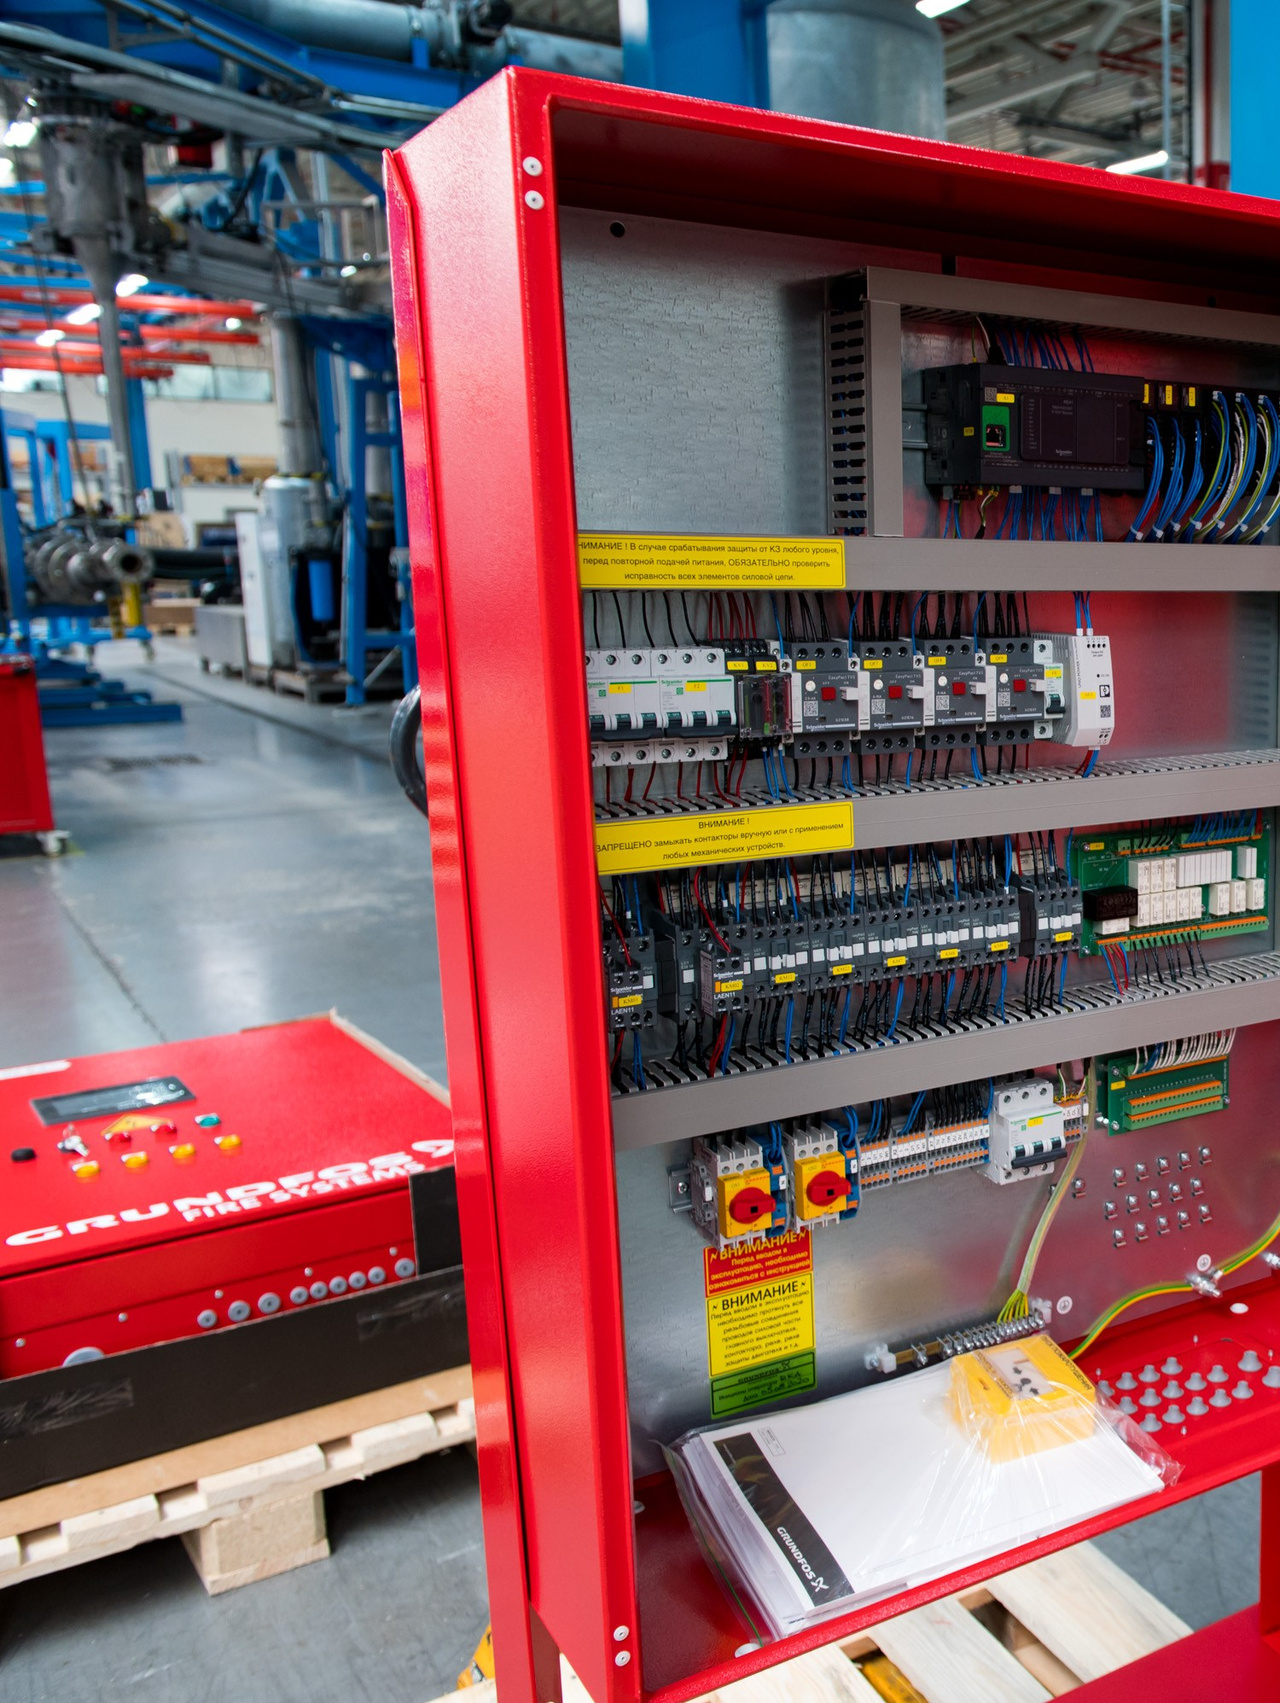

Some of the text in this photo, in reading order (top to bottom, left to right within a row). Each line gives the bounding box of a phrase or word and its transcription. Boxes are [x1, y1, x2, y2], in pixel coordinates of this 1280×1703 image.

[578, 542, 623, 551] НИМАНИЕ
[630, 542, 636, 550] В
[638, 544, 667, 553] случае
[668, 543, 725, 553] срабатывания
[812, 547, 839, 555] уровня,
[583, 558, 609, 566] перед
[611, 557, 654, 566] повторной
[656, 558, 690, 566] подачей
[692, 559, 726, 567] питания,
[728, 558, 790, 567] ОБЯЗАТЕЛЬНО
[624, 573, 676, 581] исправность
[698, 818, 745, 829] ВНИМАНИЕ
[596, 840, 652, 853] ЗАПРЕЩЕНО
[654, 838, 693, 847] замыкать
[694, 833, 739, 843] контакторы
[740, 829, 772, 840] вручную
[795, 823, 844, 834] применением
[662, 841, 785, 860] любых механических устройств.
[713, 992, 736, 1000] LAEN11
[610, 1007, 635, 1016] LAEN11
[5, 1151, 414, 1246] GRUNDFOS
[181, 1161, 427, 1223] FIRE SYSTEMS
[719, 1231, 798, 1261] ВНИМАНИЕ
[731, 1256, 755, 1266] Перед
[756, 1249, 782, 1260] вводом
[709, 1272, 759, 1291] ознакомиться
[766, 1259, 810, 1276] инструкцией
[710, 1251, 808, 1281] эксплуатацию, необходимо
[710, 1311, 733, 1321] Перед
[733, 1304, 758, 1314] вводом
[764, 1290, 810, 1306] эксплуатацию
[721, 1280, 799, 1311] ВНИМАНИЕ
[717, 1312, 758, 1327] необходимо
[759, 1304, 791, 1317] протянуть
[723, 1309, 799, 1335] резьбовые соединения
[721, 1316, 801, 1343] проводов силовой части
[784, 1334, 800, 1343] реле
[725, 1338, 755, 1350] главного
[725, 1356, 750, 1367] защиты
[751, 1347, 782, 1360] двигателя
[776, 1526, 816, 1581] GRUNDFOS
